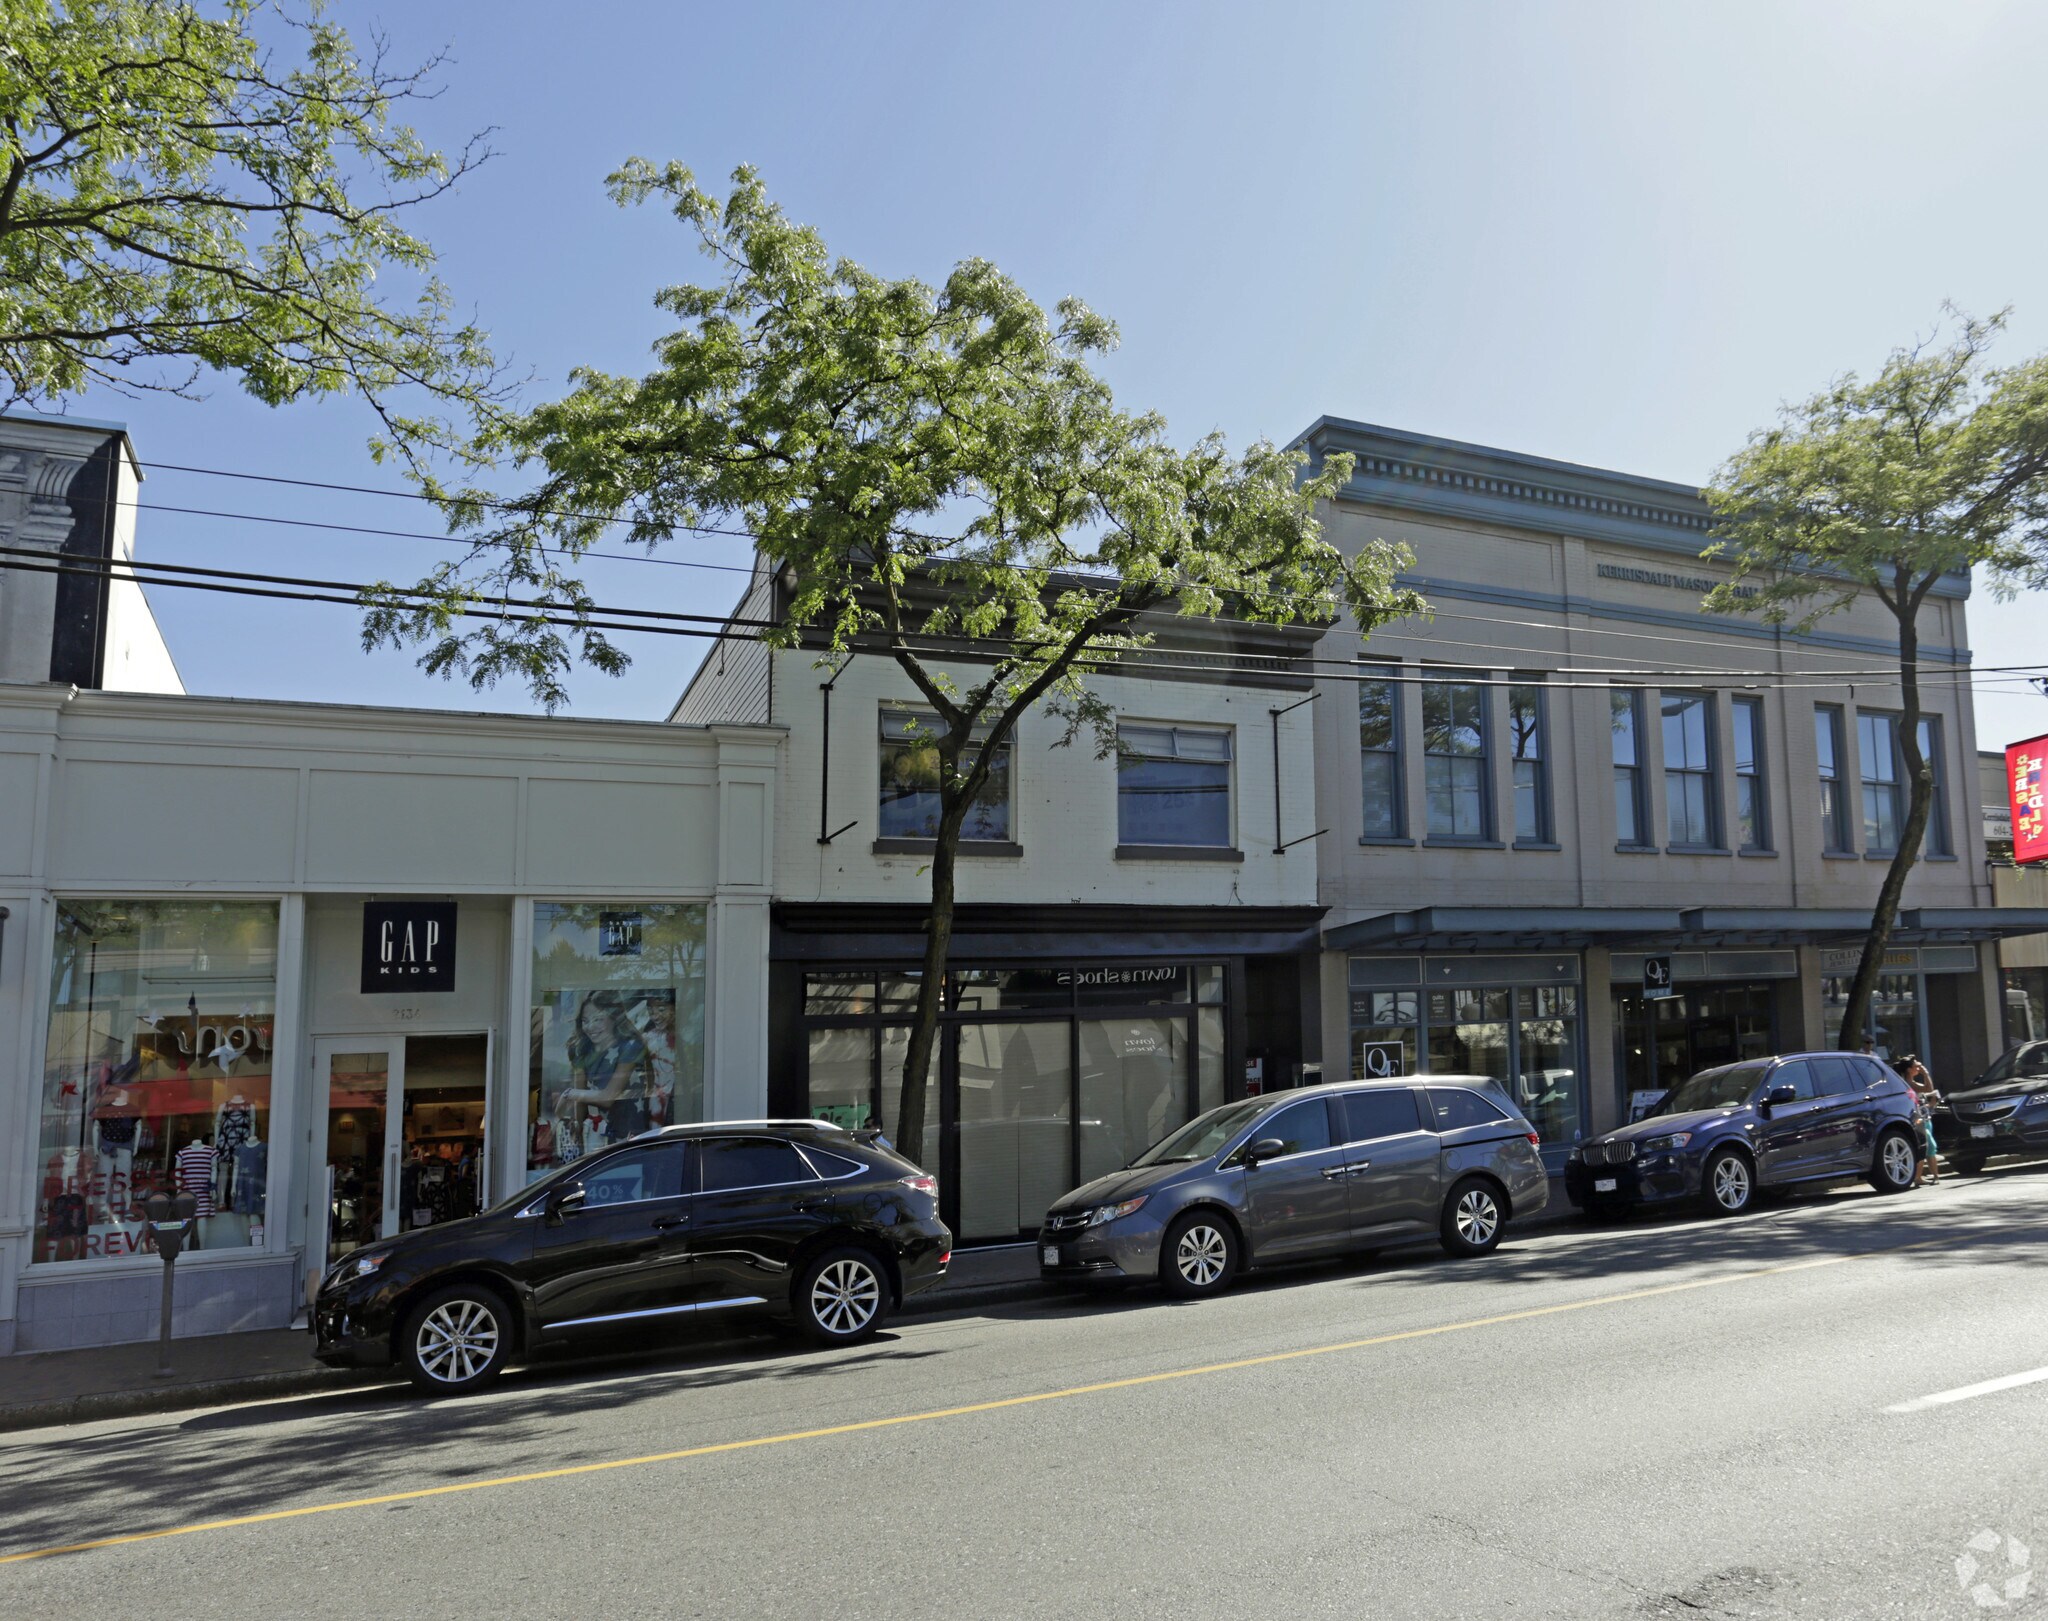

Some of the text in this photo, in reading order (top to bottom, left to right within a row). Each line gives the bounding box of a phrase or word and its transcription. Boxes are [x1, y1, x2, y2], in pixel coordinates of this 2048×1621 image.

[1597, 563, 1671, 588] KERRISDALE
[381, 920, 439, 962] GAP
[608, 926, 633, 945] GAP
[380, 966, 438, 974] KIDS
[1644, 988, 1671, 998] HOME
